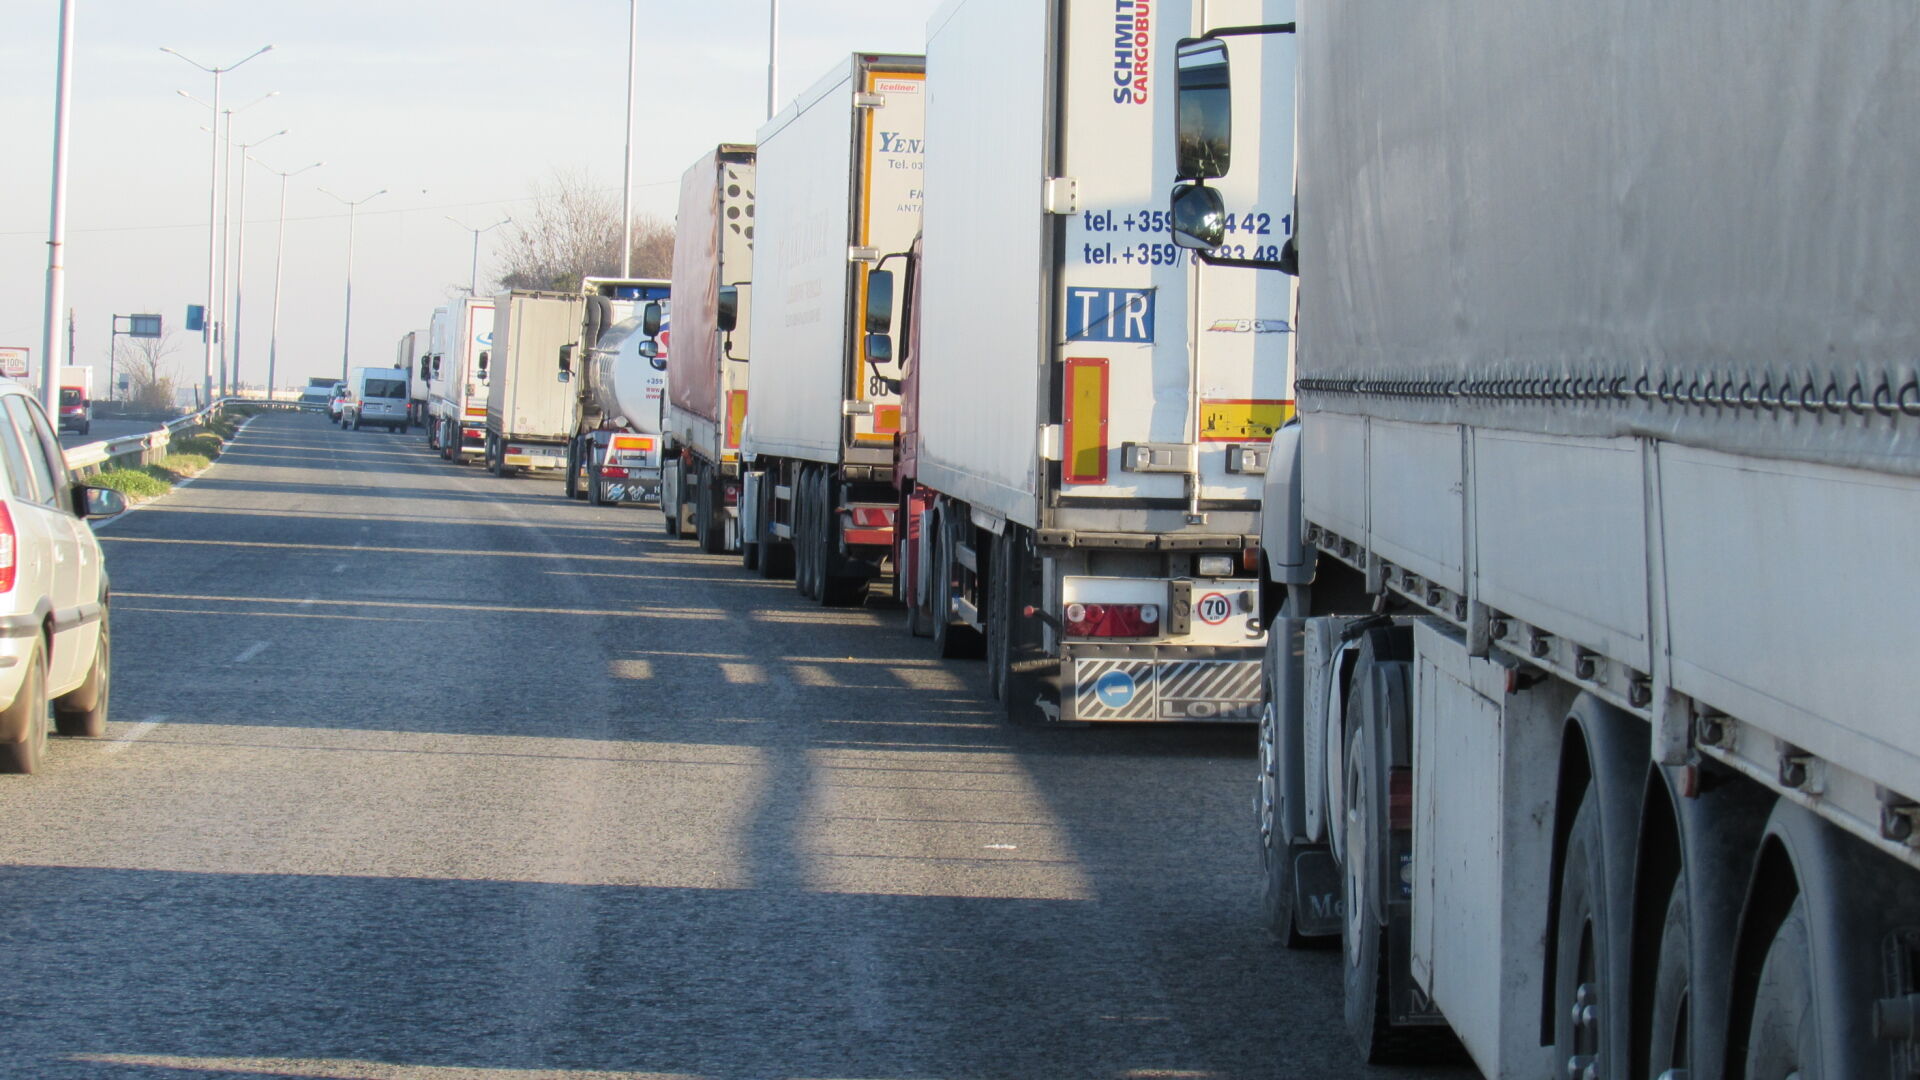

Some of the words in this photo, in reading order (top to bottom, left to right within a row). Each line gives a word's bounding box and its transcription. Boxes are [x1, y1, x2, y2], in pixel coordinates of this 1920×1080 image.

[1133, 0, 1150, 105] CARGOBU
[1075, 291, 1147, 339] TIR
[1205, 600, 1226, 615] 70
